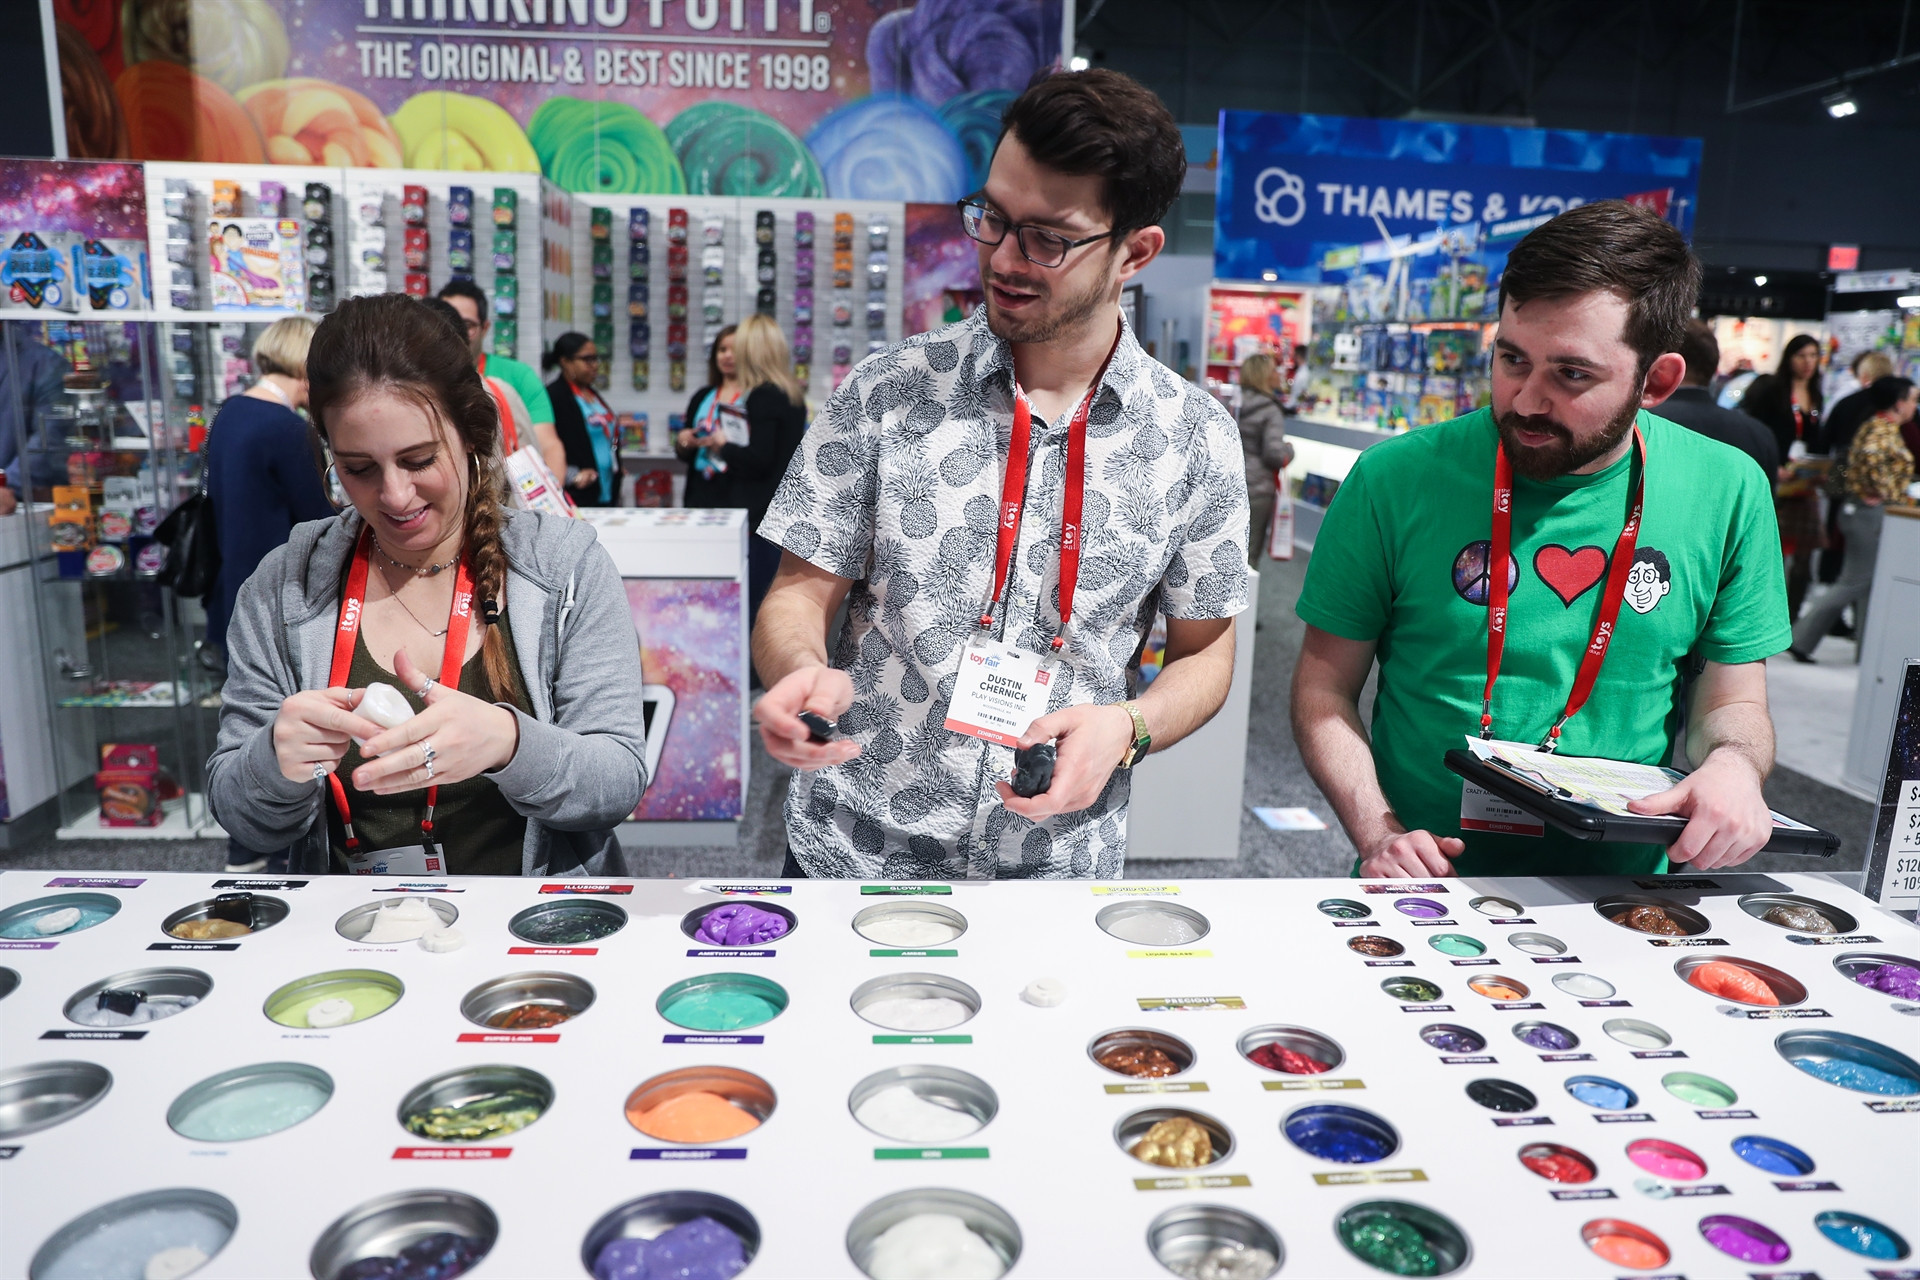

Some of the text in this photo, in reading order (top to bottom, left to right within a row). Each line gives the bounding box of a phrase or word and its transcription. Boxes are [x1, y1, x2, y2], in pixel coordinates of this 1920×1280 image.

[356, 41, 830, 91] THE ORIGINAL & BEST SINCE 1998
[1317, 183, 1474, 223] THAMES
[1482, 192, 1508, 222] &
[987, 673, 1023, 691] DUSTIN
[971, 691, 987, 701] PLAY
[988, 695, 1013, 709] VISIONS
[979, 681, 1028, 702] CHERNICK
[977, 729, 1004, 741] EXHIBITOR
[1164, 996, 1217, 1004] PRECIOUS
